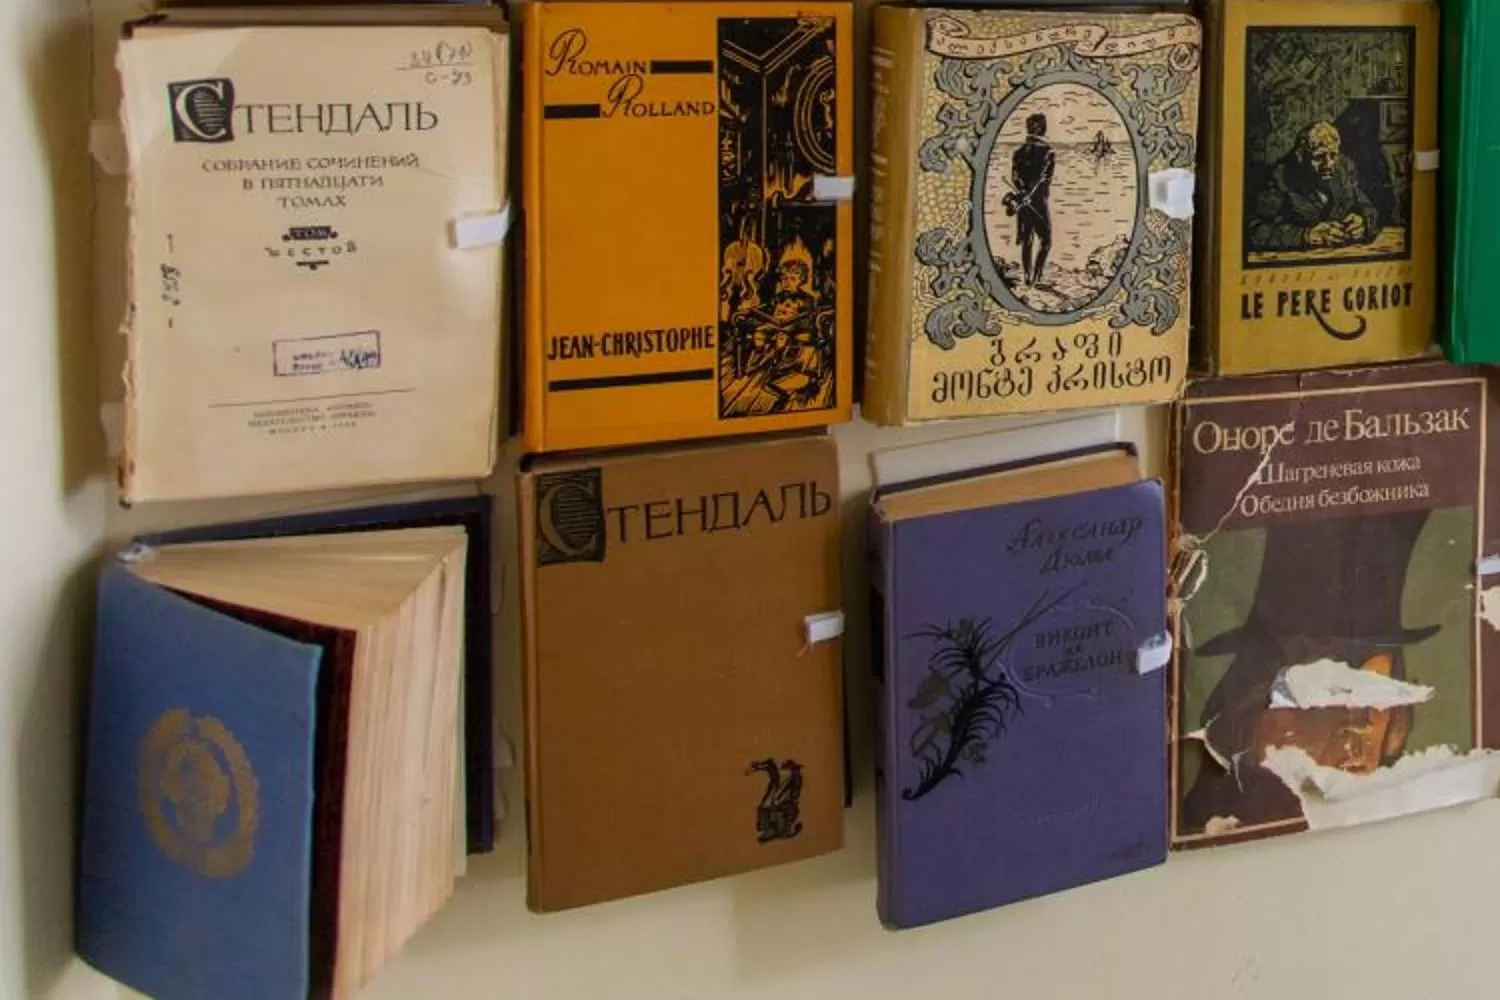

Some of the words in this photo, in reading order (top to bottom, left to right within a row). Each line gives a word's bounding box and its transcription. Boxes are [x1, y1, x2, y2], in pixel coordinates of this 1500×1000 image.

[546, 27, 648, 78] ROMAIN
[174, 81, 439, 140] СТЕНДАЛЬ
[603, 73, 716, 119] ROLLAND
[201, 157, 301, 173] СОБРАНИЕ
[306, 152, 420, 170] СОЧИНЕНИЙ
[260, 175, 385, 192] ПЯТНАДЦАТИ
[278, 195, 347, 209] ТОМАХ
[1241, 292, 1263, 320] LE
[1343, 281, 1414, 312] GORIOT
[547, 324, 716, 361] JEAN-CHRISTOPHE
[990, 330, 1122, 367] გრაფი
[931, 364, 1034, 404] მონტე
[1047, 354, 1172, 394] კრისტო
[1193, 420, 1296, 455] Оноре
[1305, 417, 1340, 445] де
[1343, 406, 1473, 441] Бальзак
[1257, 458, 1374, 486] Шагреневая
[1377, 454, 1422, 474] кожа
[539, 473, 832, 556] СТЕНДАЛЬ
[1240, 491, 1316, 518] Обедня
[1318, 481, 1430, 508] безбожника
